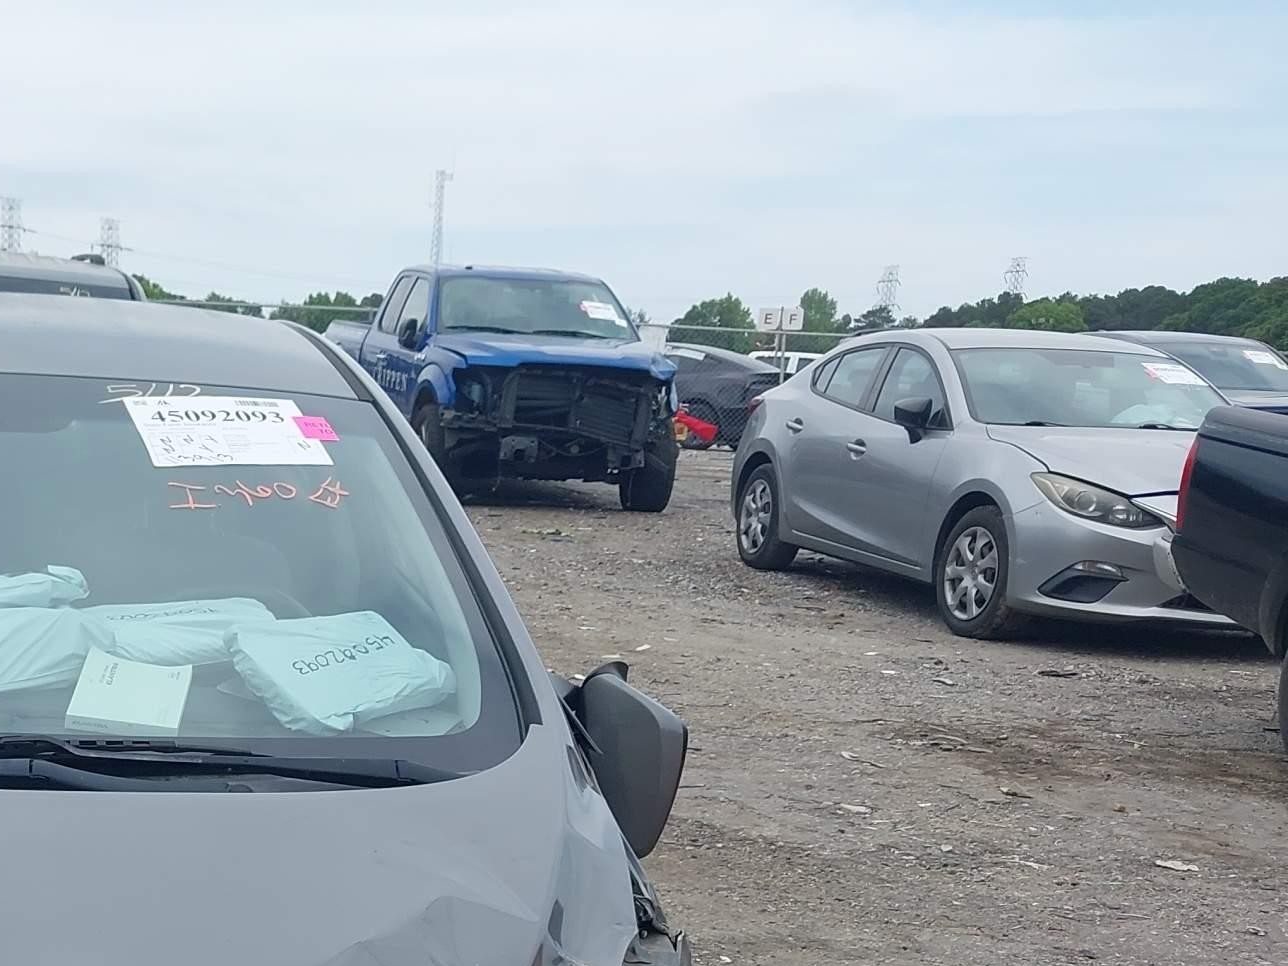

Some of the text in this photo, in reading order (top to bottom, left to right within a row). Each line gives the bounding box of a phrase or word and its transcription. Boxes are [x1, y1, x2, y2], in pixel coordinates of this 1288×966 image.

[764, 313, 773, 325] E
[789, 313, 798, 325] F
[151, 409, 285, 424] 45092093
[292, 635, 396, 675] 45092093
